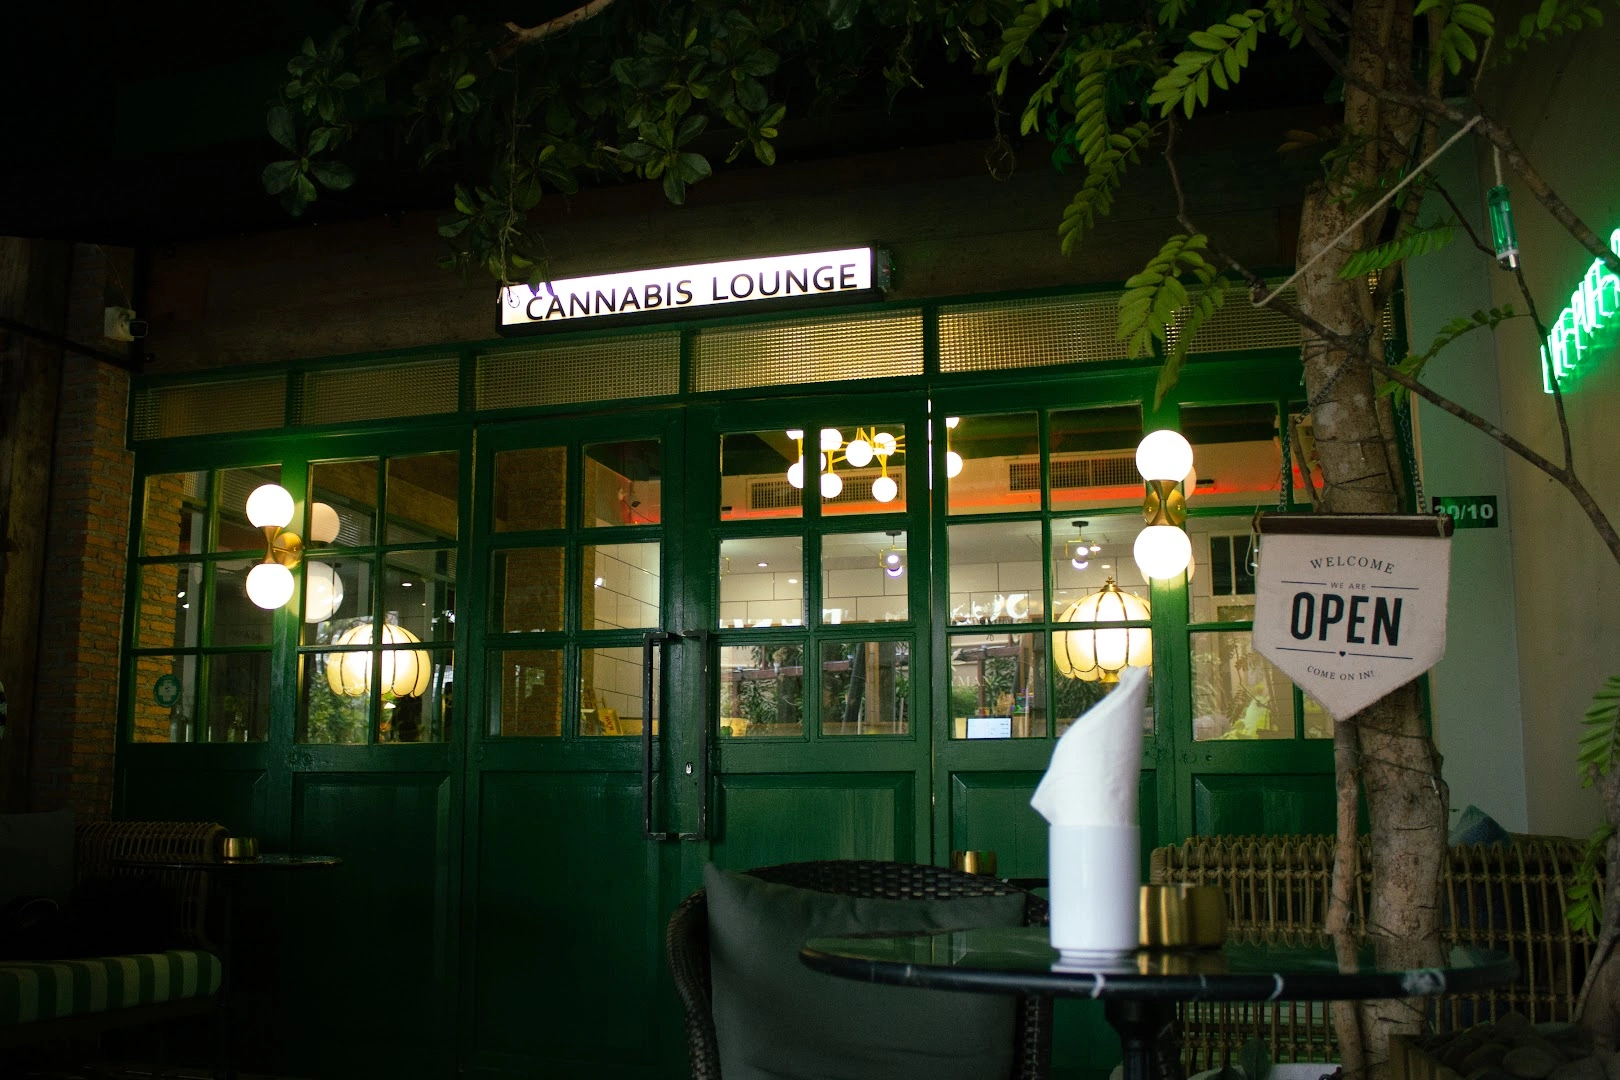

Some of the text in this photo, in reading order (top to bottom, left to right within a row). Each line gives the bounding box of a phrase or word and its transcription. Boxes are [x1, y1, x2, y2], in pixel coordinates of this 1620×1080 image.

[525, 263, 858, 320] CANNABIS LOUNGE
[1310, 555, 1395, 575] WELCOME
[1290, 591, 1403, 646] OPEN
[1307, 665, 1375, 681] COME ON IN!
